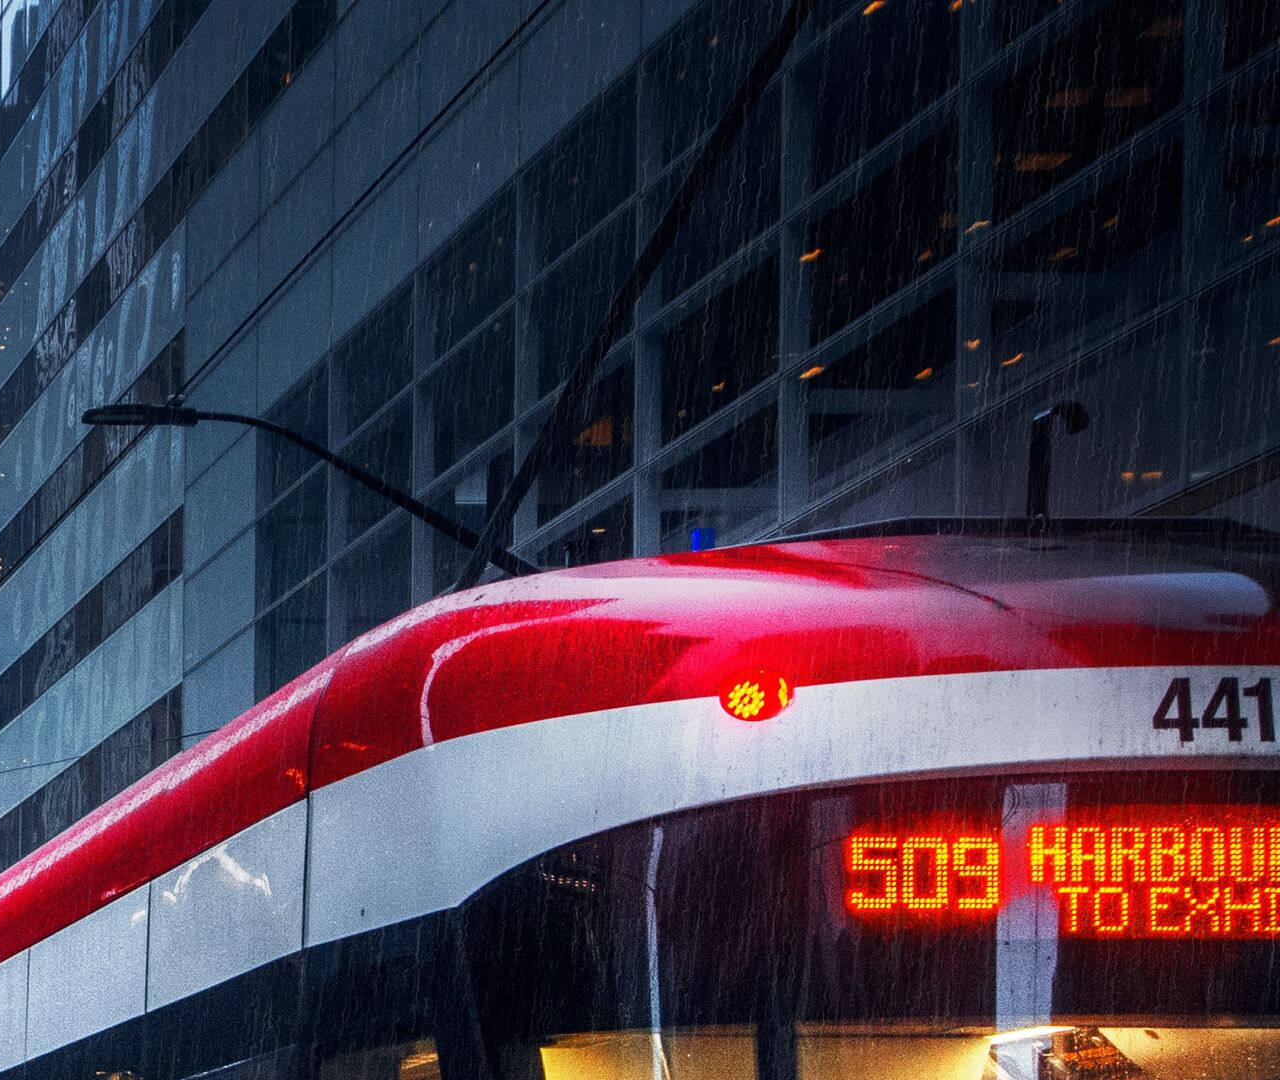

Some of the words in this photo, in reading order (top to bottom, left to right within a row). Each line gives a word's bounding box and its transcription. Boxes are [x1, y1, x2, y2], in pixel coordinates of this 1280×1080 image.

[1152, 677, 1276, 743] 441
[851, 836, 1000, 910] 509
[1058, 886, 1129, 933] TO
